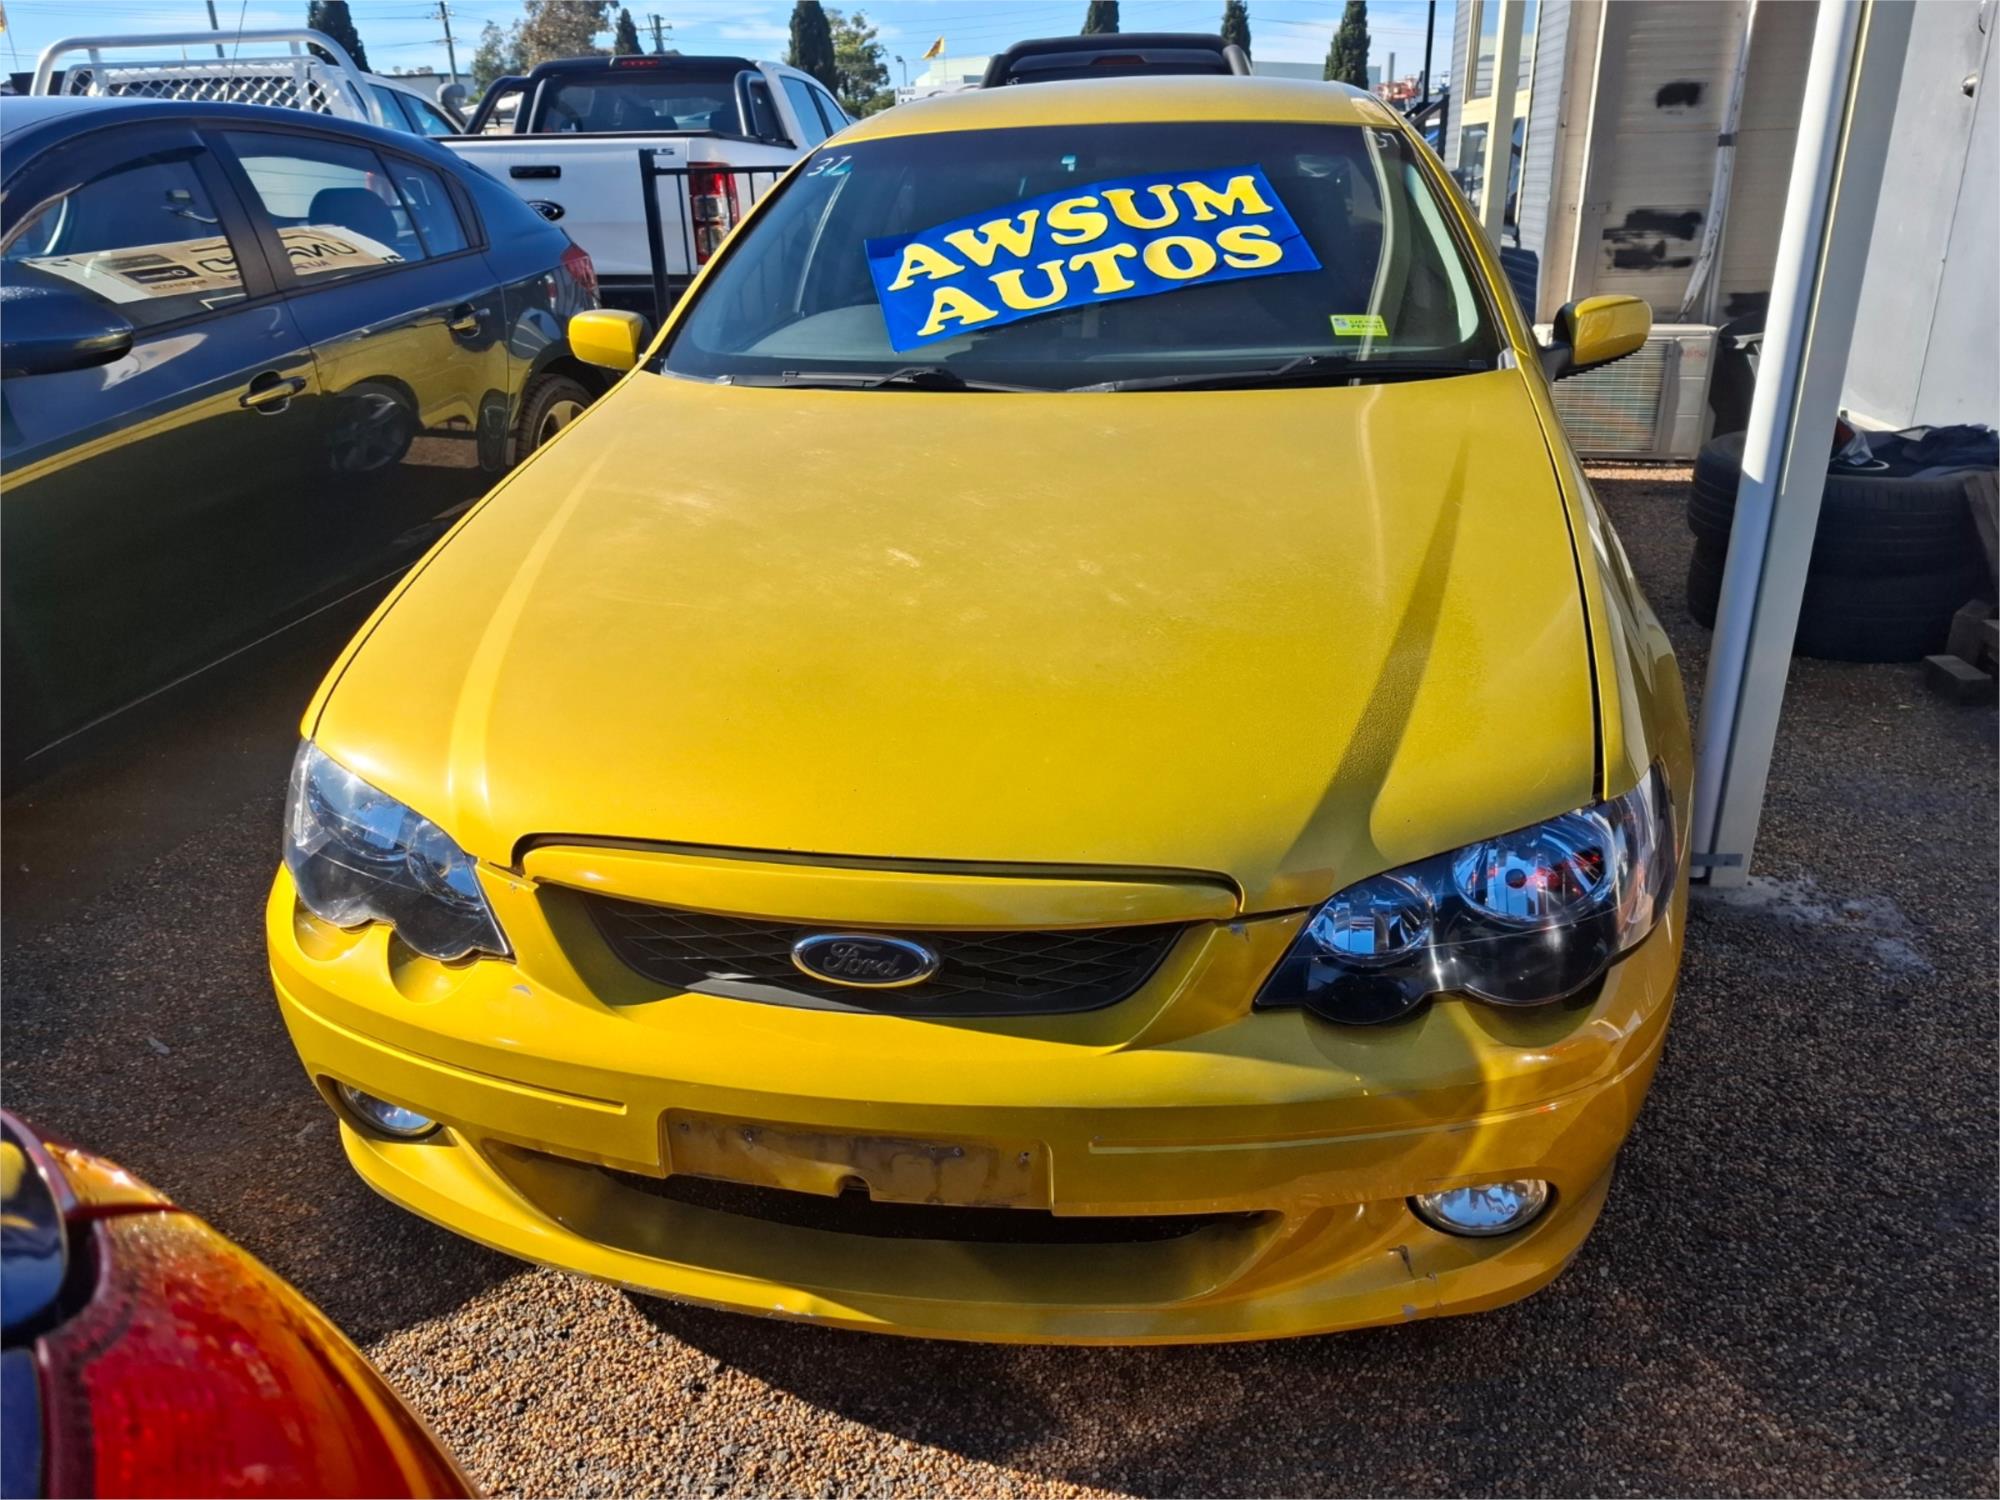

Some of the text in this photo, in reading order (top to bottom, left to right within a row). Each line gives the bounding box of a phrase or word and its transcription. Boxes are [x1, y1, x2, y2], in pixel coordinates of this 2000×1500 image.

[887, 175, 1273, 292] AWSUM
[916, 225, 1284, 337] AUTOS
[823, 942, 900, 977] Ford
